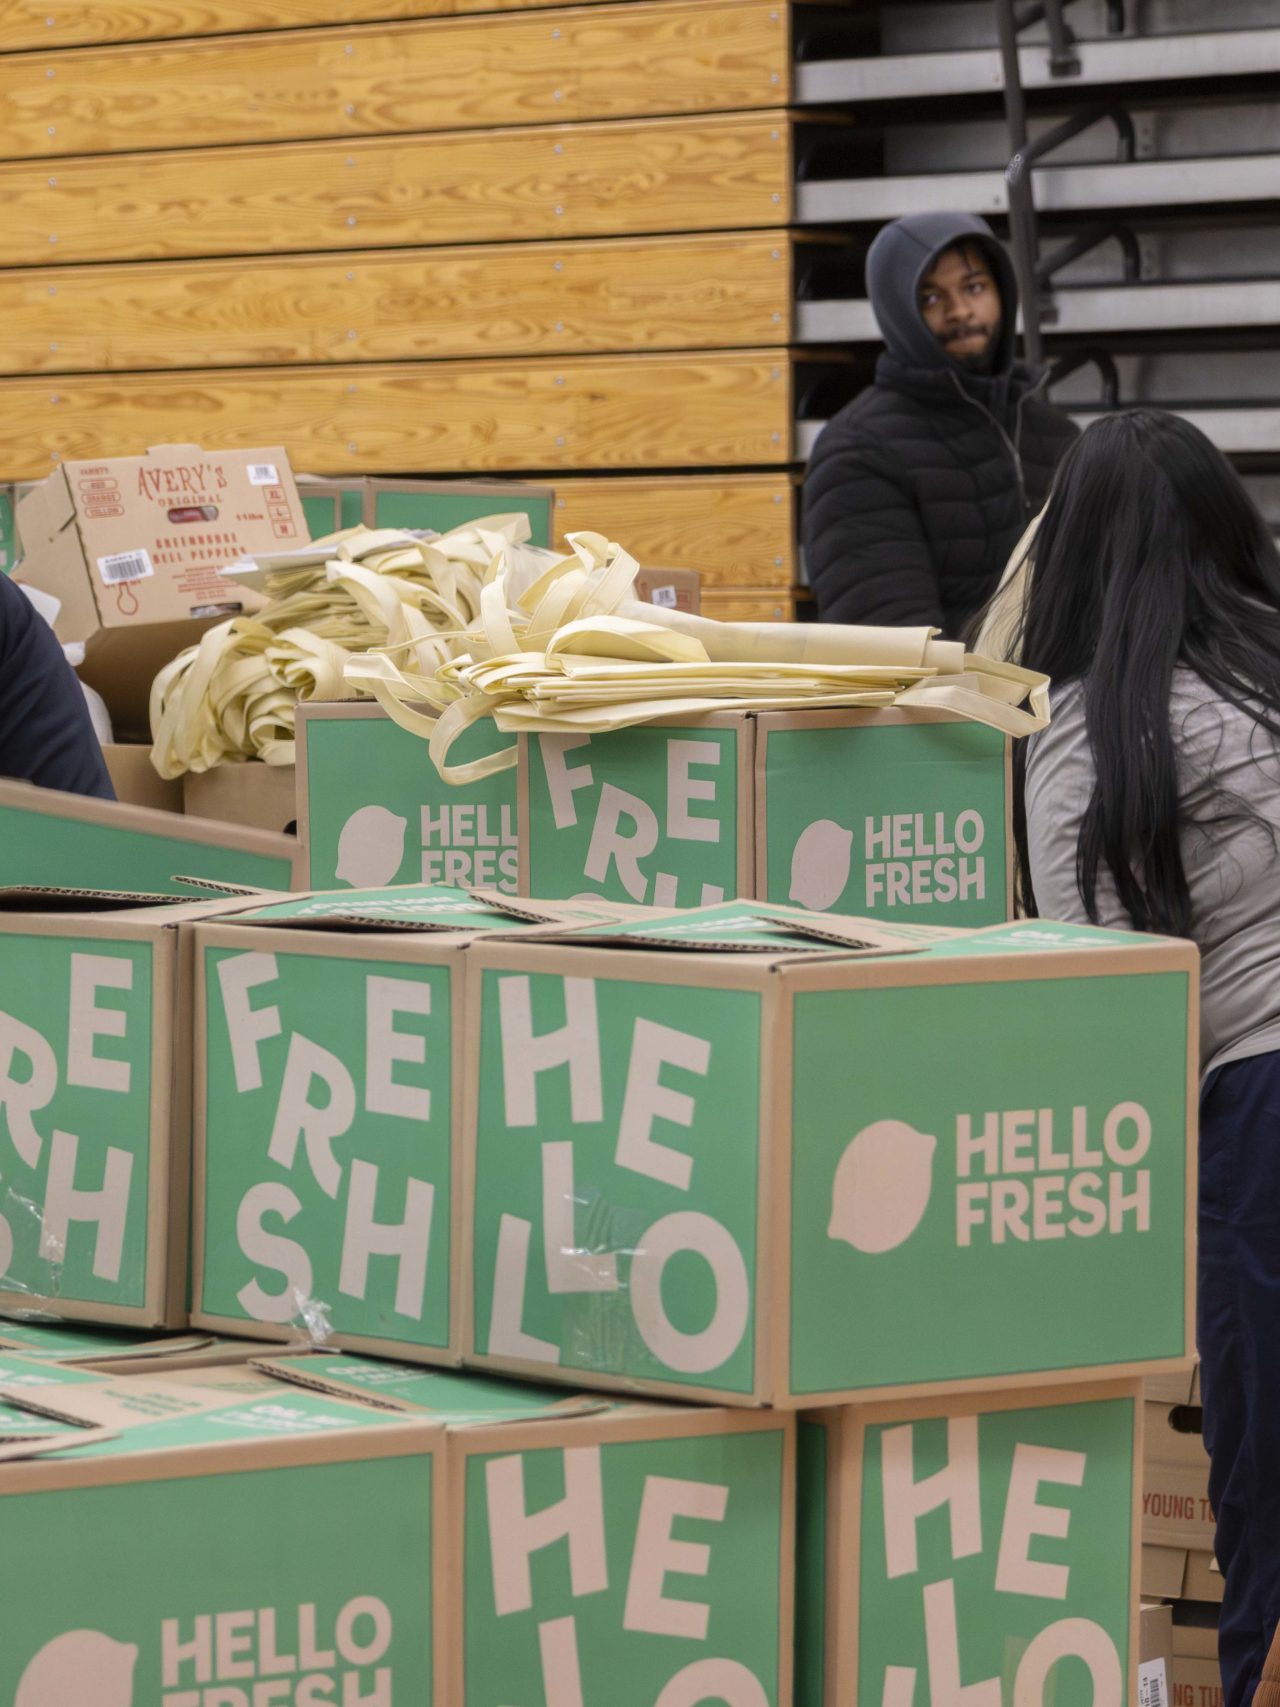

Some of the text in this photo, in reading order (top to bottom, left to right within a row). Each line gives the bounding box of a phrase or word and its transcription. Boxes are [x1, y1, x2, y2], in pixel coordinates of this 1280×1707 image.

[138, 464, 228, 501] AVERY'S
[158, 494, 223, 507] ORIGINAL
[152, 553, 183, 565] BELL
[155, 533, 238, 549] GREENHOUSE
[421, 804, 518, 846] HELL
[864, 808, 985, 859] HELLO
[865, 857, 985, 907] FRESH
[956, 1101, 1152, 1177] HELLO
[956, 1170, 1151, 1247] FRESH
[1142, 1493, 1194, 1521] YOUNG
[161, 1595, 393, 1687] HELLO
